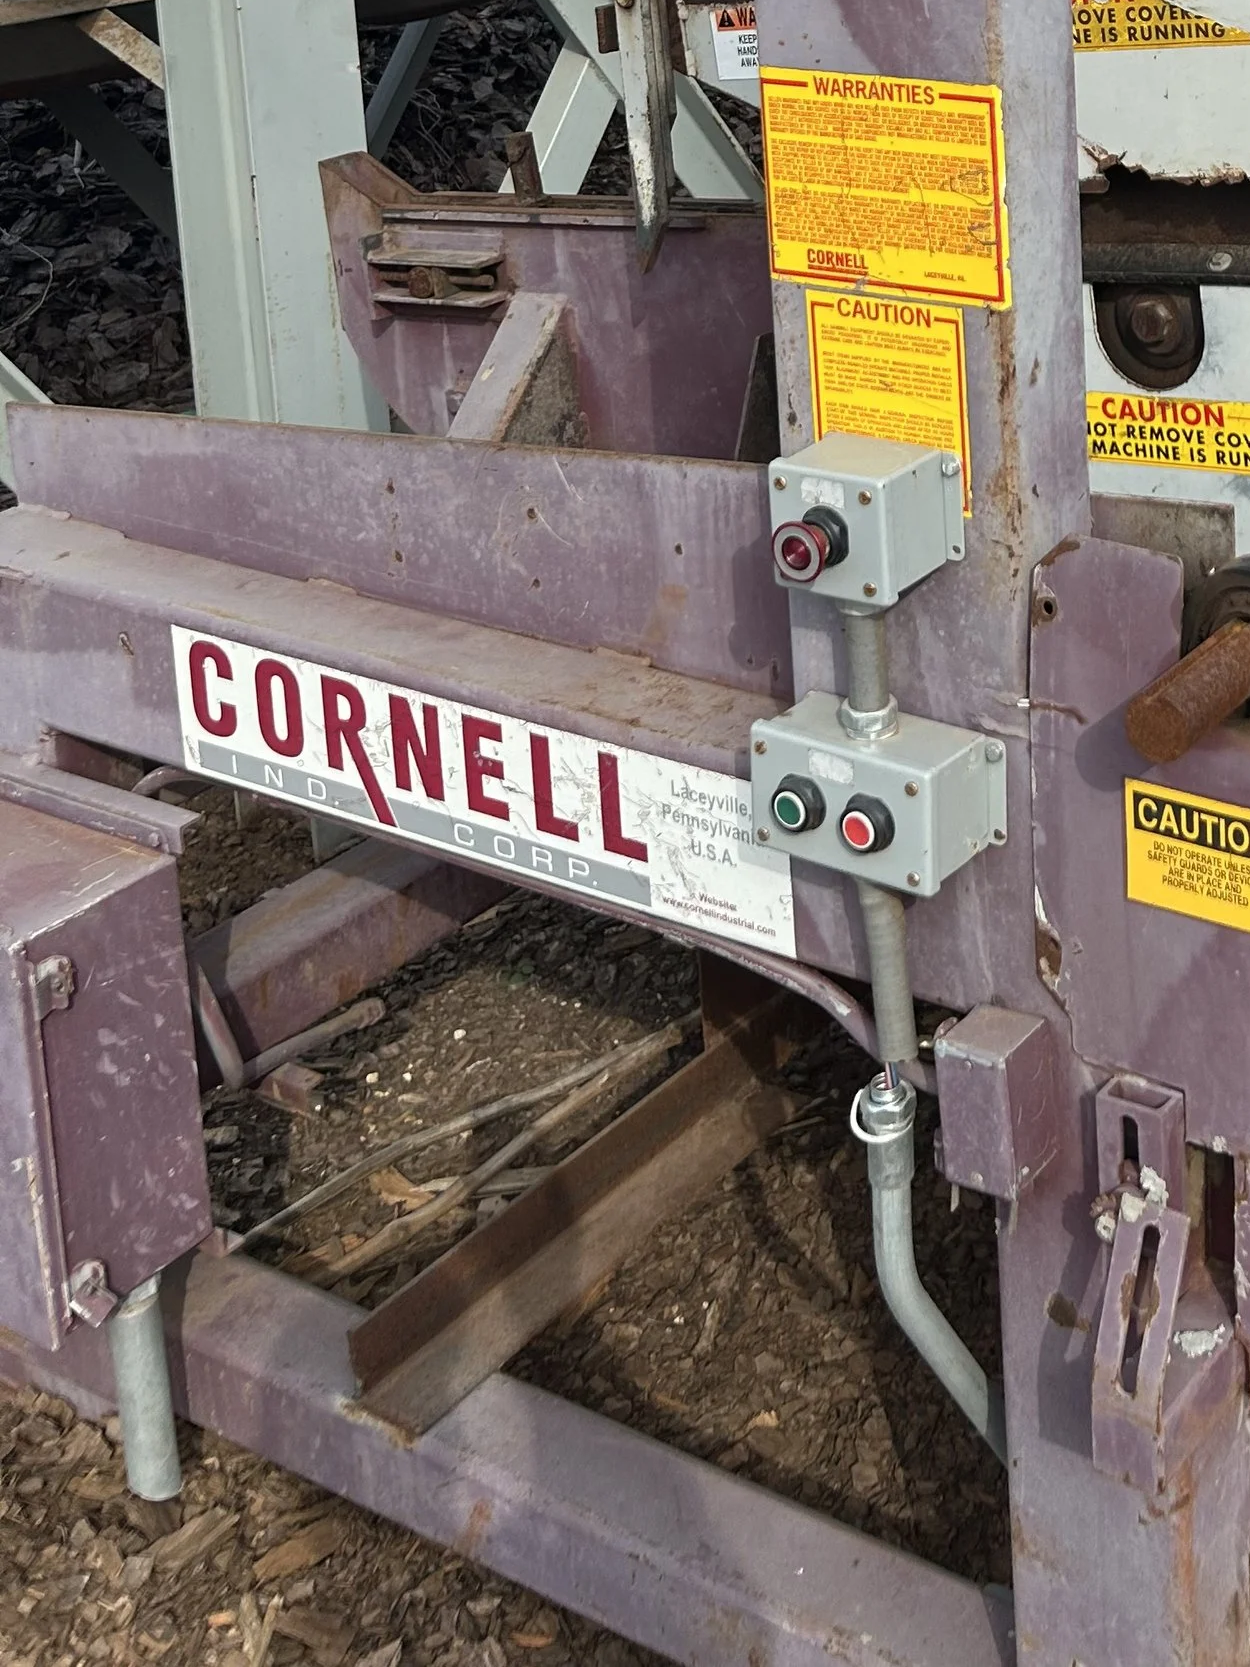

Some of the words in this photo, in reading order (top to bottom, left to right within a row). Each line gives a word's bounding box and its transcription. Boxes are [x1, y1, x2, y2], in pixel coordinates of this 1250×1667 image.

[738, 34, 758, 44] KEEP
[1101, 26, 1118, 43] IS
[1127, 22, 1226, 42] RUNNING
[737, 46, 758, 56] HAND
[812, 75, 936, 105] WARRANTIES
[807, 248, 869, 270] CORNELL
[836, 297, 932, 328] CAUTION
[1102, 397, 1225, 428] CAUTION
[1126, 424, 1206, 445] REMOVE
[1092, 439, 1181, 460] MACHINE
[1190, 447, 1206, 462] IS
[189, 640, 649, 863] CORNELL
[670, 779, 752, 821] Laceyville,
[231, 754, 340, 807] IND.
[454, 823, 598, 886] CORP.
[662, 803, 764, 848] Pennsylvani
[690, 838, 738, 868] U.S.A.
[1148, 850, 1177, 865] SAFETY
[1180, 858, 1212, 876] GUARDS
[1214, 868, 1227, 880] OR
[1154, 840, 1165, 852] DO
[1167, 844, 1182, 856] NOT
[1185, 849, 1222, 868] OPERATE
[1162, 875, 1204, 894] PROPERLY
[1206, 888, 1248, 907] ADJUSTED
[1168, 867, 1184, 879] ARE
[1186, 872, 1194, 882] IN
[1196, 875, 1222, 890] PLACE
[1224, 882, 1242, 894] AND
